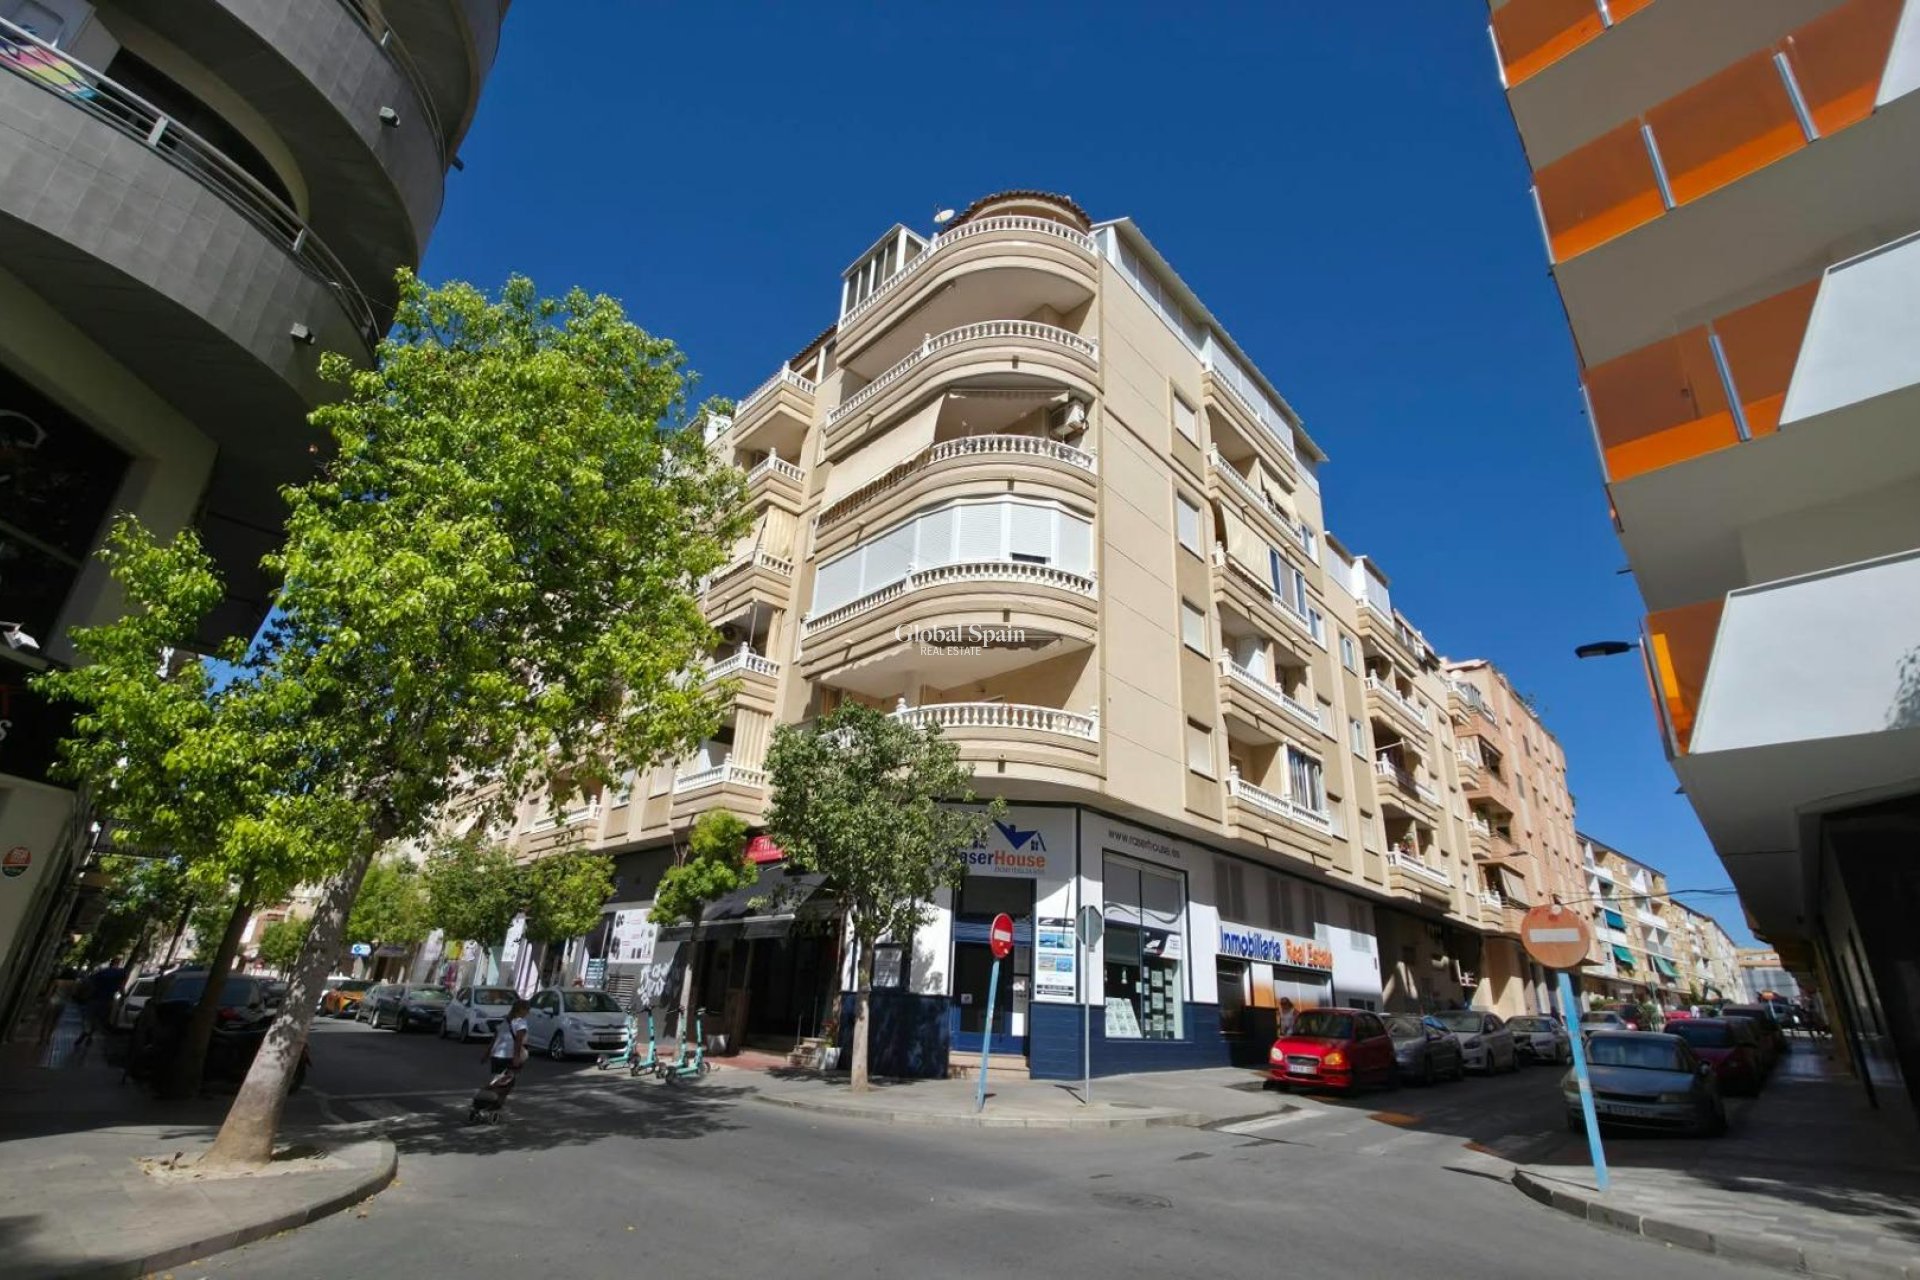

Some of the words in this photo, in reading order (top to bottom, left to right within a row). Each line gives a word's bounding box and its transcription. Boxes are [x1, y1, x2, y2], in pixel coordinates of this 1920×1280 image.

[957, 848, 1045, 868] aserHouse
[1219, 925, 1281, 962] Inmobiliaria
[1284, 938, 1305, 965] Real
